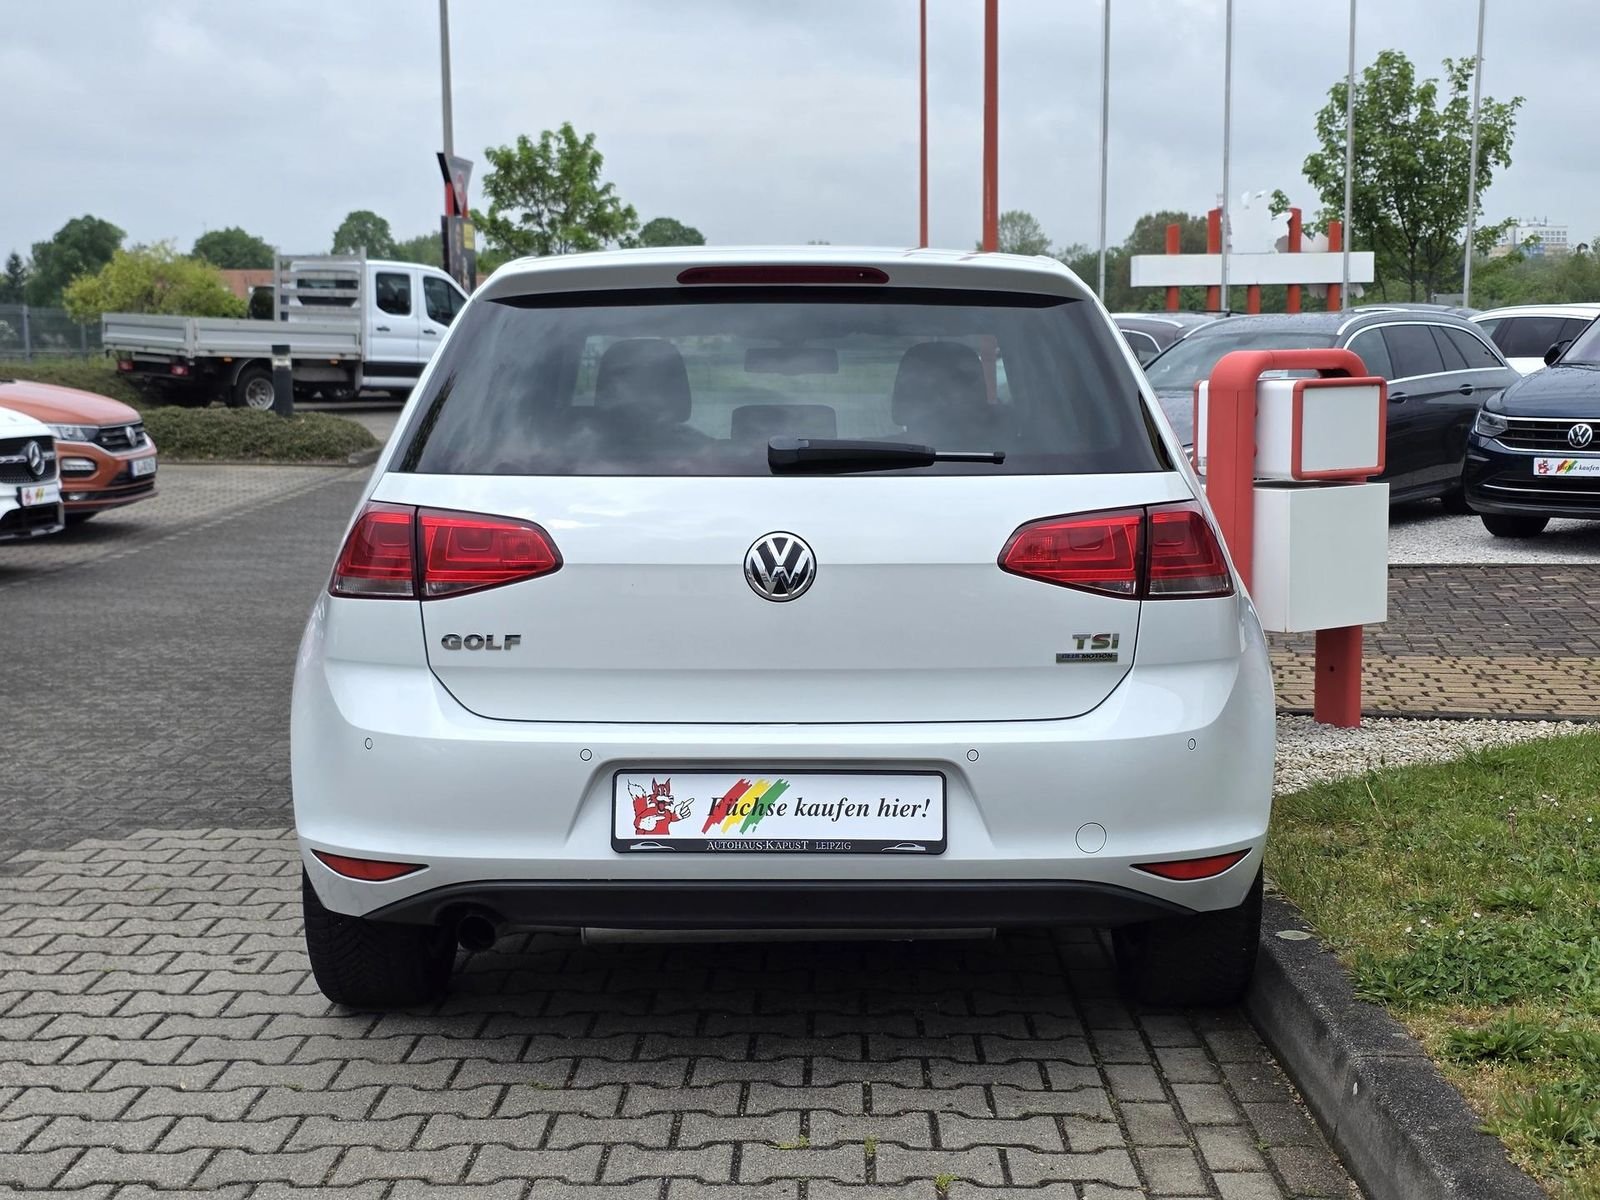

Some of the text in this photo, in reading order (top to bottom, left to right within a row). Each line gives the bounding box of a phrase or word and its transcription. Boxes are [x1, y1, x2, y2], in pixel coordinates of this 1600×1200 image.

[441, 633, 521, 650] GOLF
[1072, 633, 1120, 649] TSI
[707, 797, 931, 822] Füchse kaufen hier!
[815, 841, 851, 850] LEIPZIG
